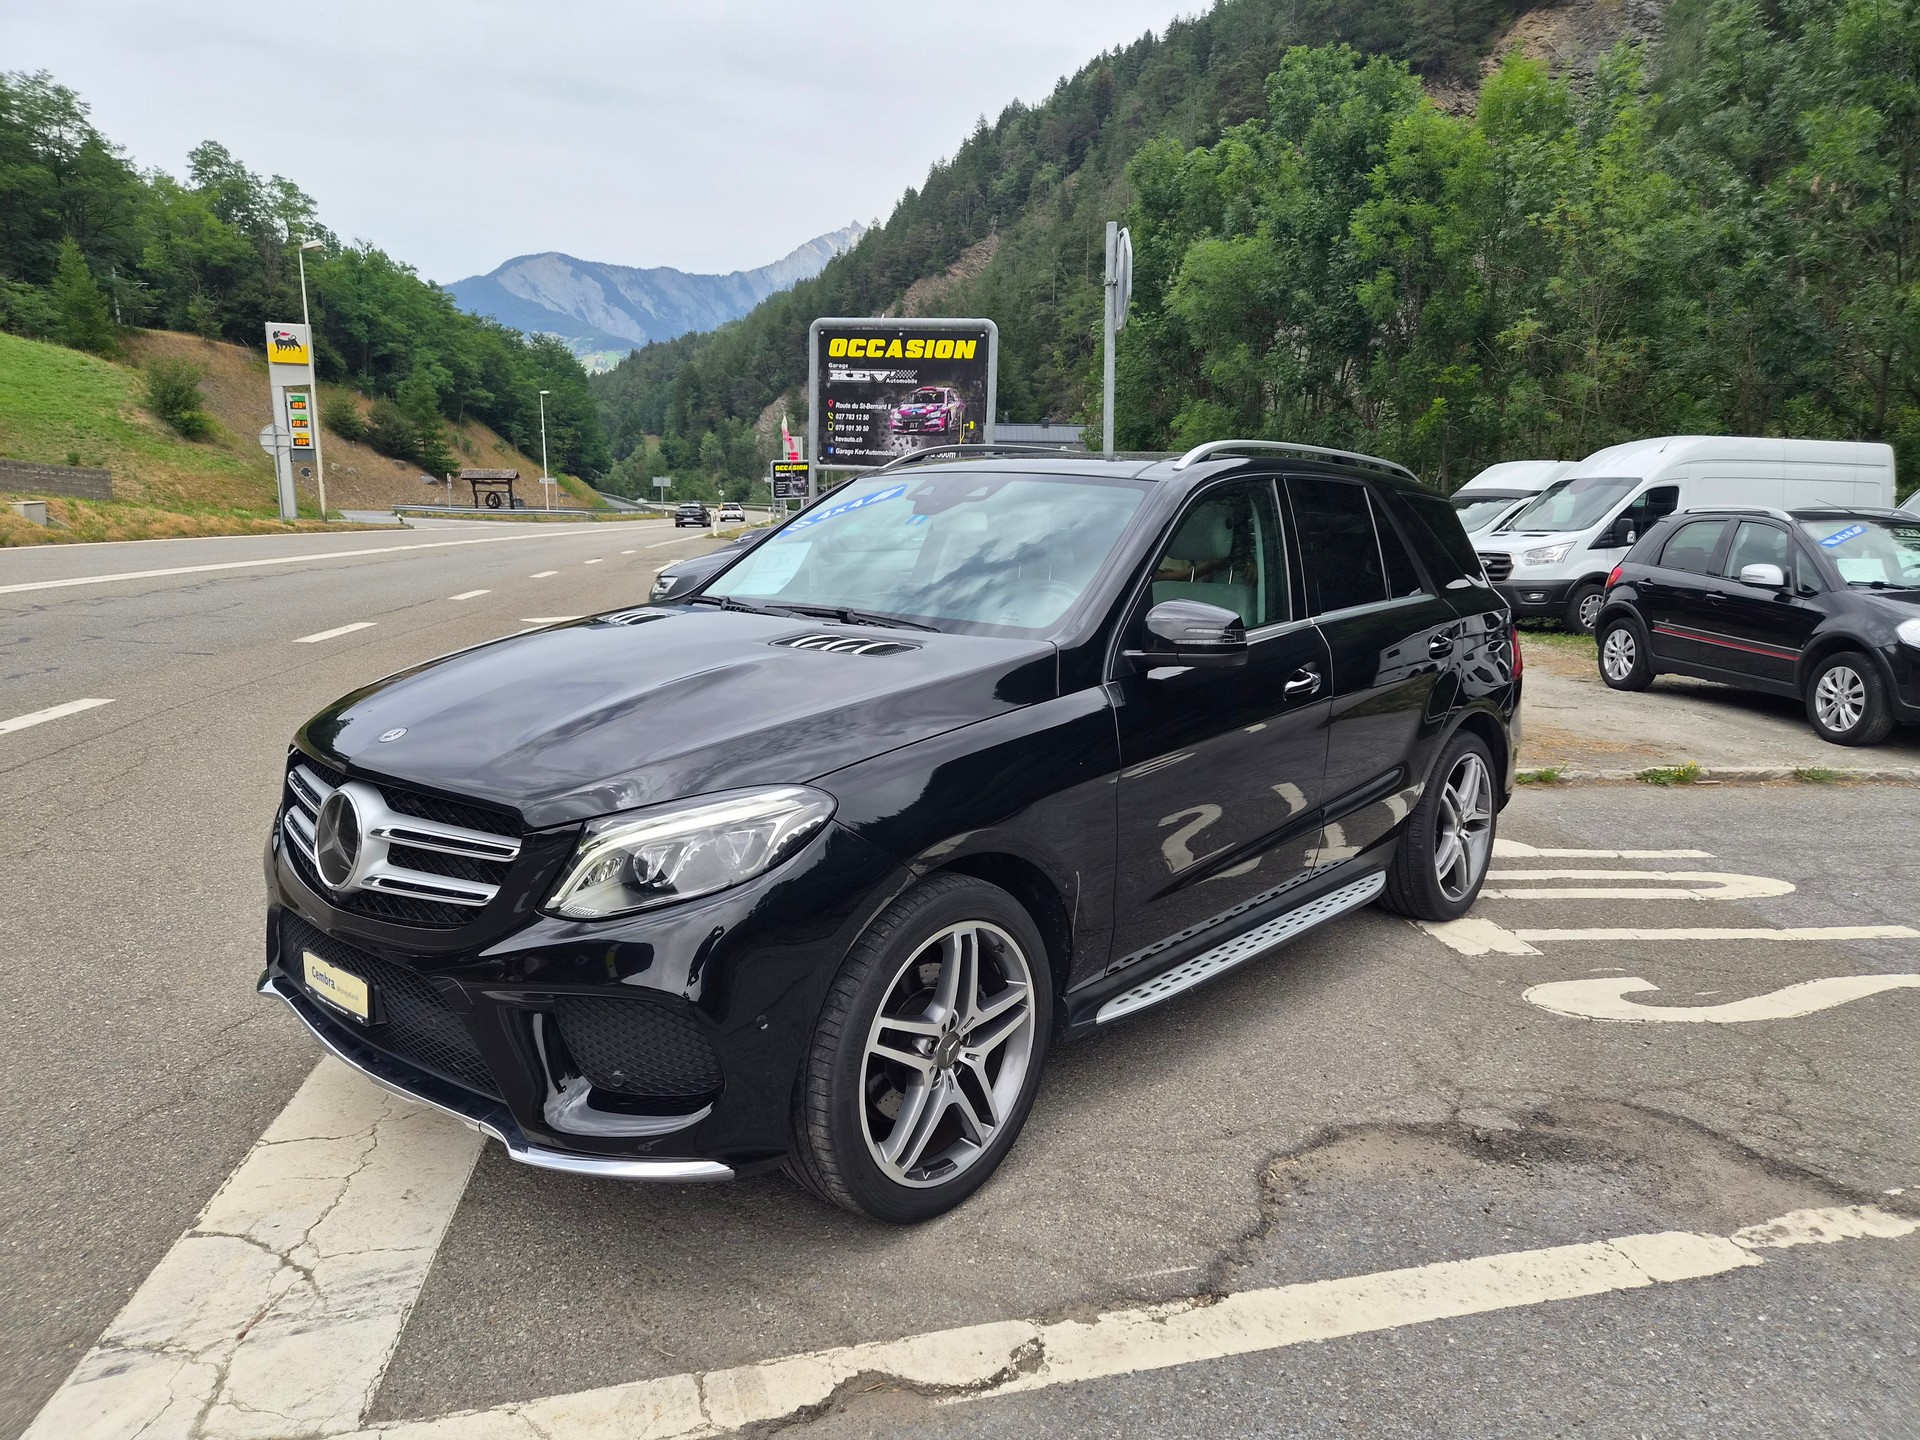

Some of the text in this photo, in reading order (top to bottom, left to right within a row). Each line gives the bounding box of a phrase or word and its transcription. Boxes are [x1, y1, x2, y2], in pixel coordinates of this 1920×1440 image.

[828, 338, 977, 359] OCCASION
[860, 402, 887, 410] St-Bernard
[835, 447, 854, 456] Garage
[311, 966, 336, 990] Cembra
